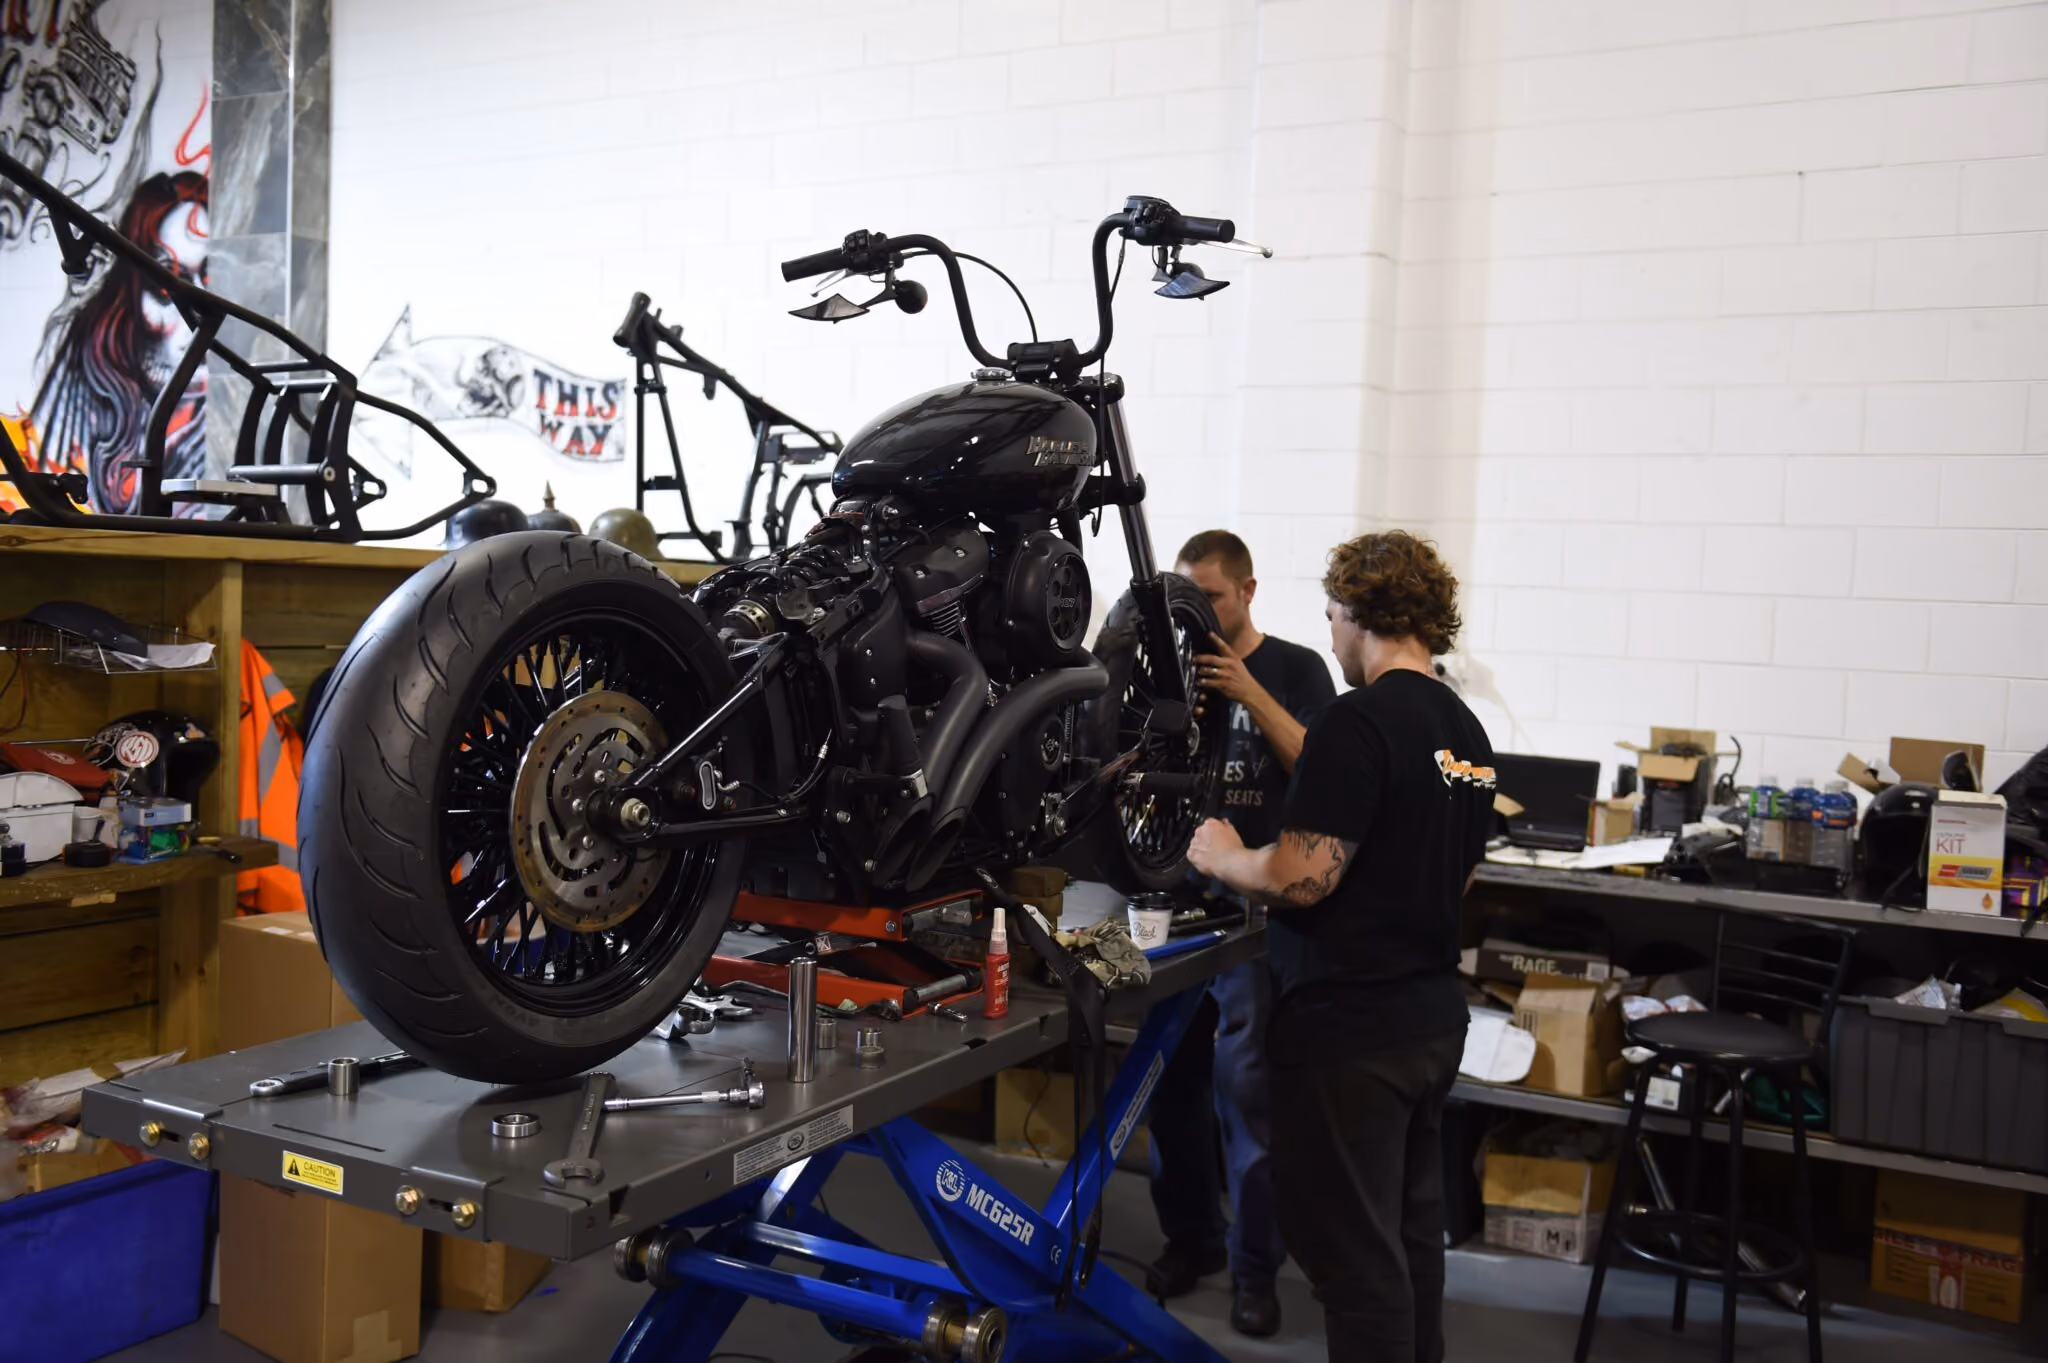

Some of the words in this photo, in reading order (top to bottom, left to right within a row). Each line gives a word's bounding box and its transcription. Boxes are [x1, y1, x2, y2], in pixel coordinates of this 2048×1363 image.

[534, 368, 618, 420] THIS
[540, 413, 612, 456] WAY
[1225, 789, 1263, 806] SEATS
[1936, 838, 1966, 854] KIT
[304, 1161, 336, 1178] CAUTION
[965, 1183, 1035, 1246] MC625R
